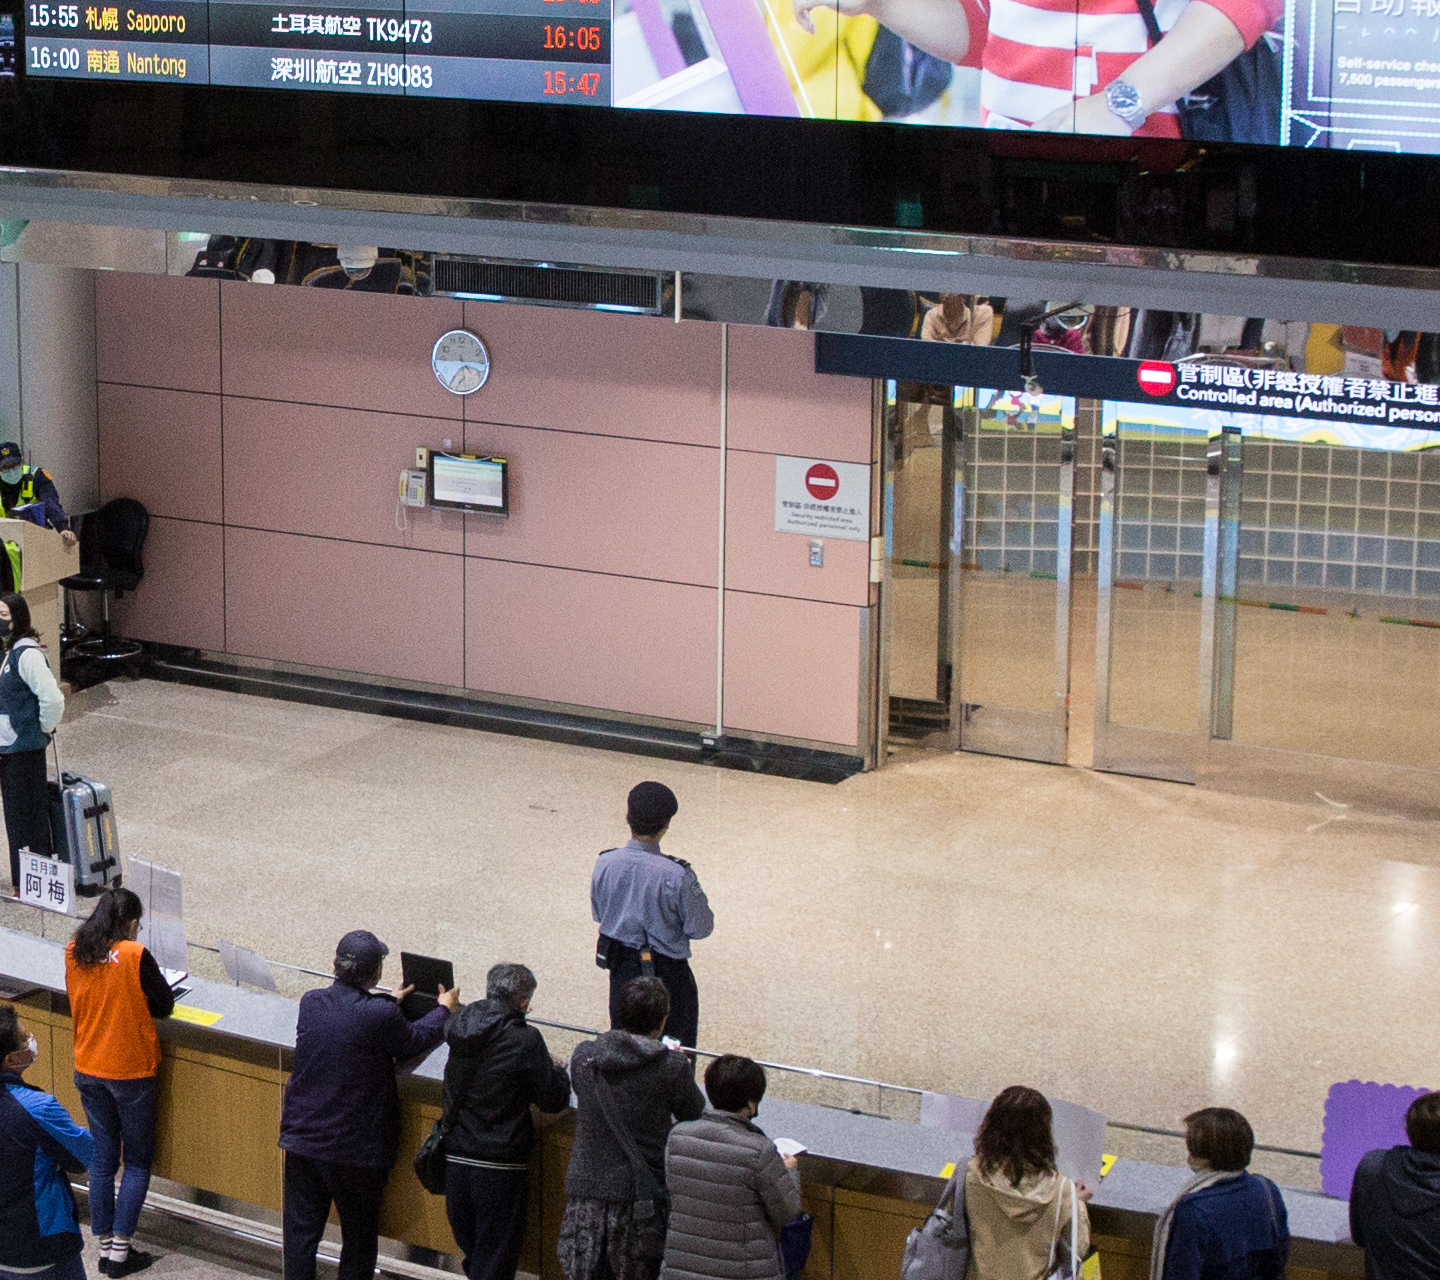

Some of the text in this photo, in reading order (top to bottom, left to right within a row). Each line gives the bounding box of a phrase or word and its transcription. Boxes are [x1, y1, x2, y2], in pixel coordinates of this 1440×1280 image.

[30, 45, 601, 96] 16:00 南通 Nantong 深圳航空 ZH9083 15:47
[1337, 56, 1411, 71] Self-service
[1339, 73, 1372, 86] 7,500
[1177, 384, 1257, 406] Controlled
[1259, 395, 1293, 410] area
[1295, 398, 1386, 419] (Authorized
[26, 873, 65, 904] 阿梅
